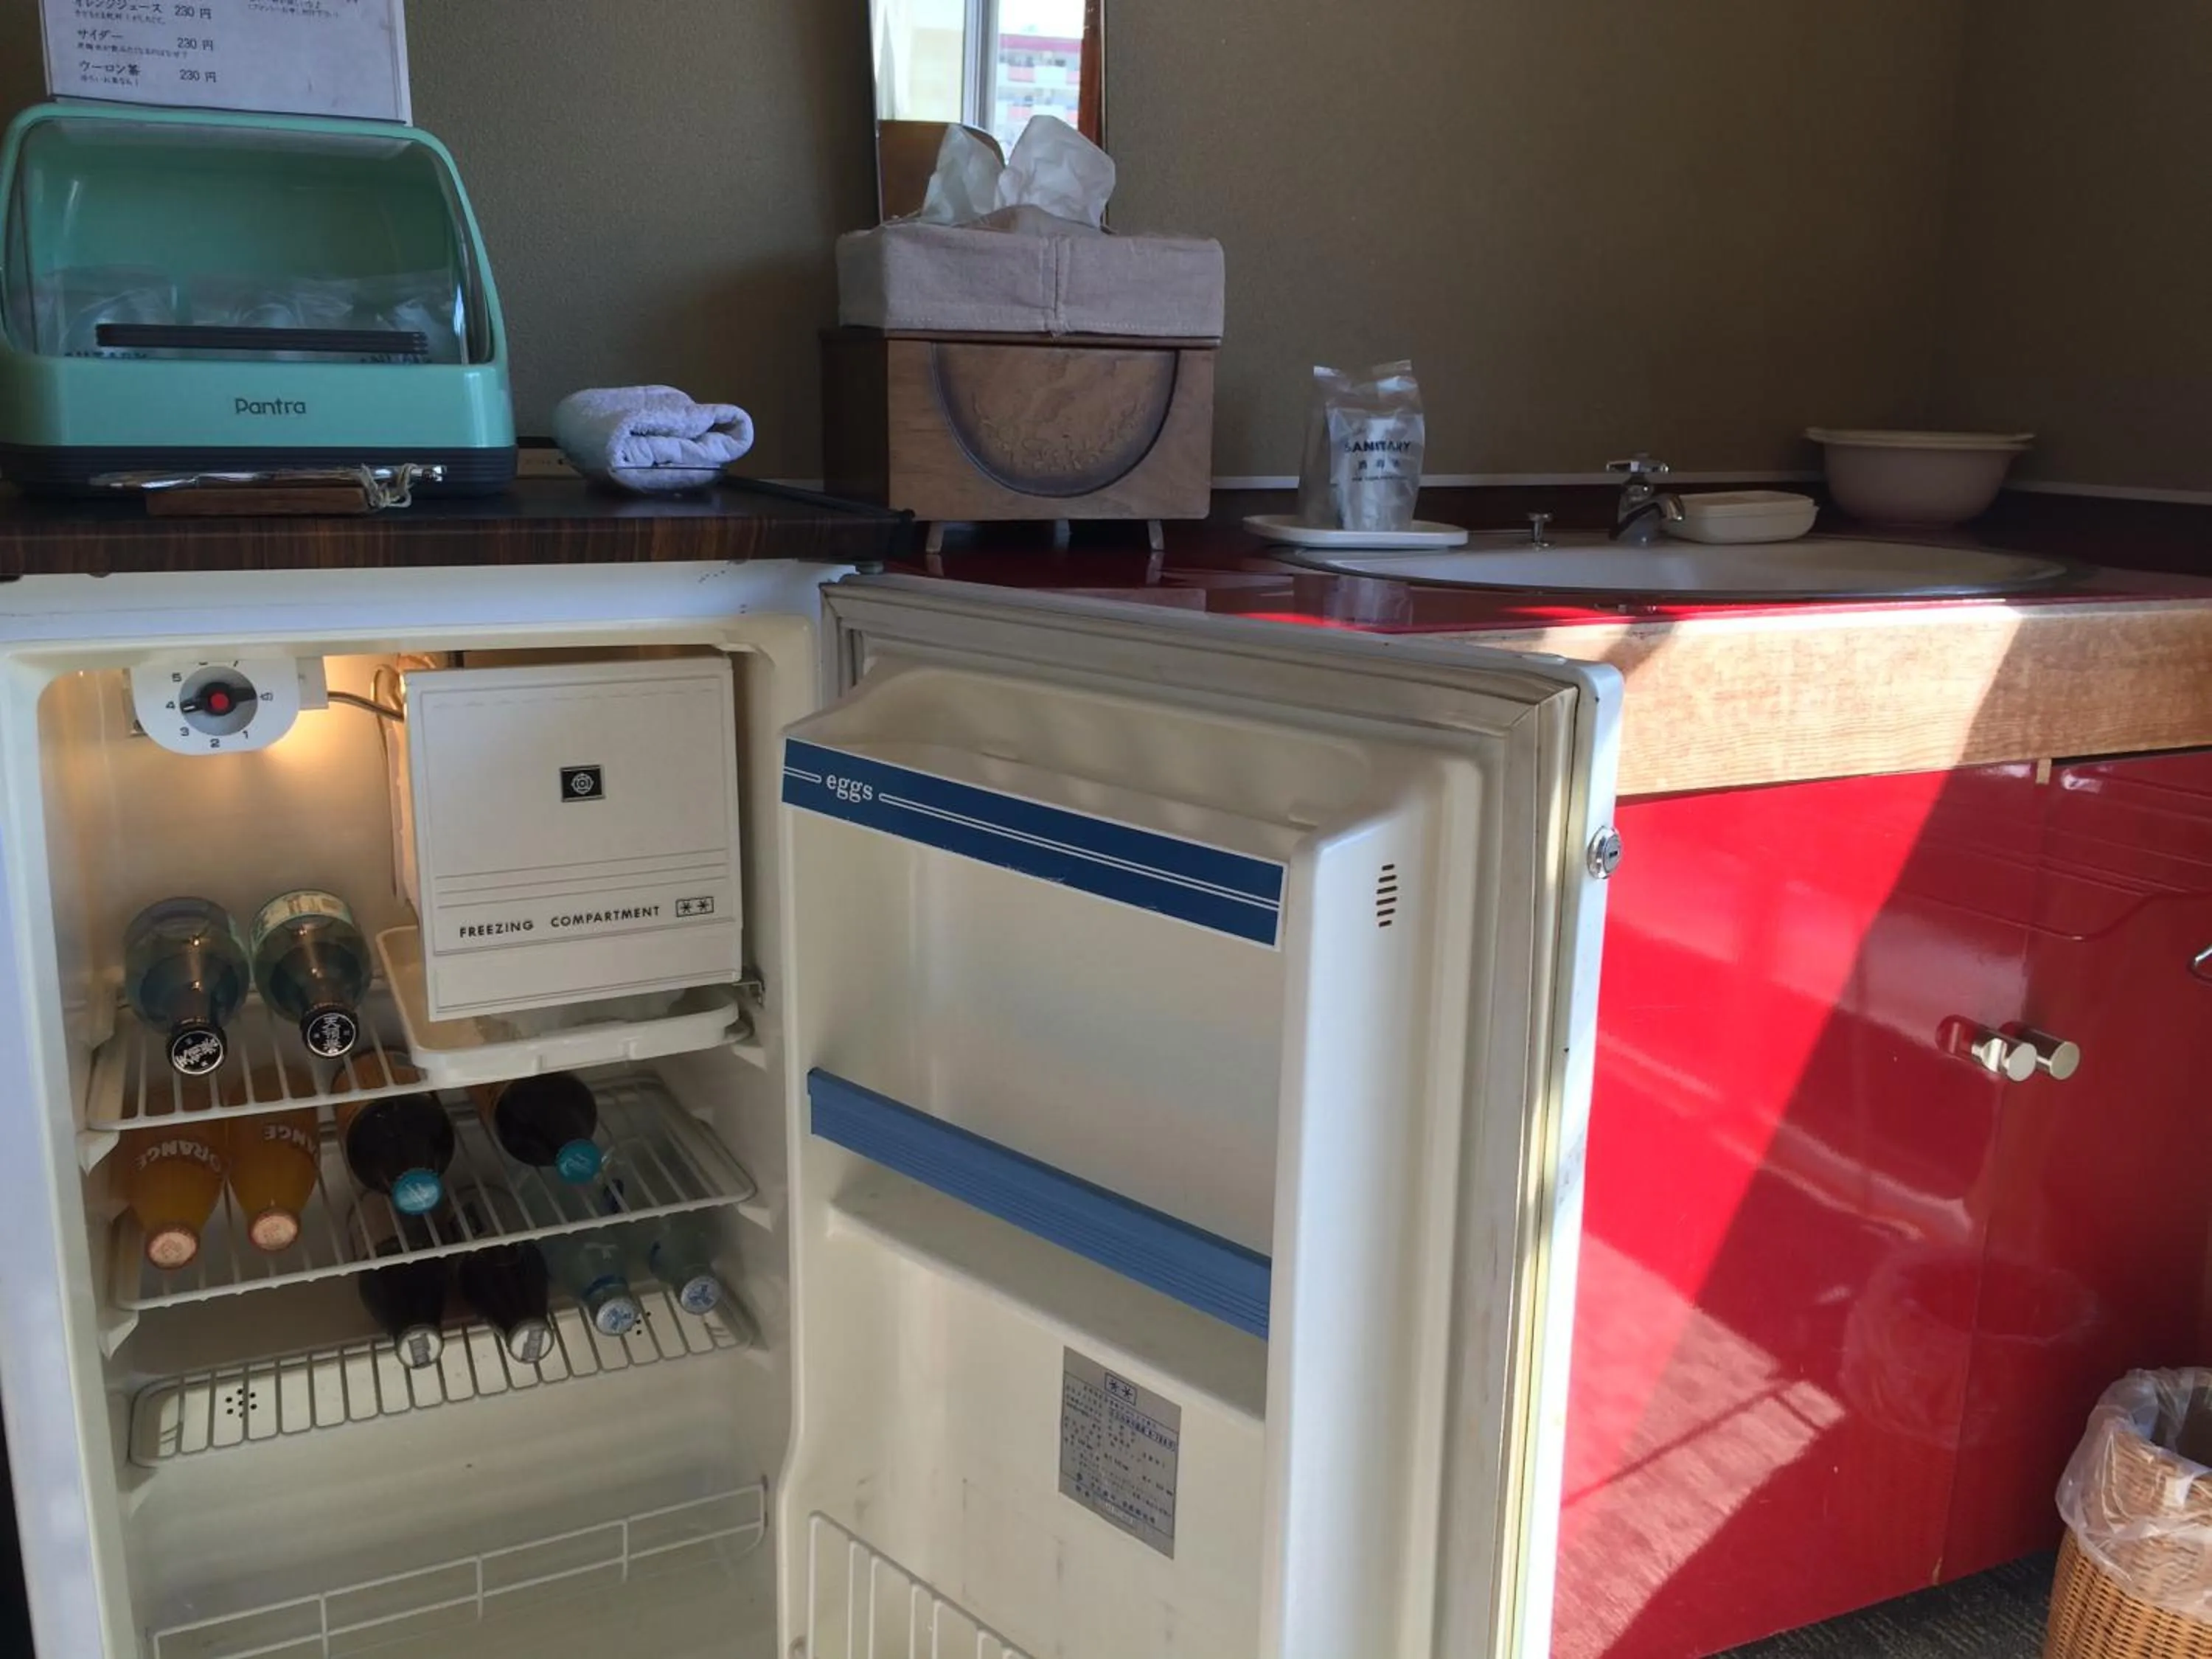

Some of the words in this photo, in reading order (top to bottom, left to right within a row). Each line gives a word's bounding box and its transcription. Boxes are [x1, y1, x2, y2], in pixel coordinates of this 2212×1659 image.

[174, 4, 195, 18] 230
[200, 7, 212, 20] 円
[77, 29, 124, 41] サイダー
[177, 37, 198, 50] 230
[202, 39, 214, 52] 円
[79, 60, 141, 77] ウーロン茶
[179, 69, 200, 82] 230
[205, 71, 217, 83] 円
[234, 397, 307, 415] Pantra
[172, 672, 181, 682] 5
[166, 701, 175, 709] 4
[180, 727, 189, 737] 3
[243, 731, 248, 739] 1
[210, 739, 220, 748] 2
[826, 774, 874, 803] eggs
[459, 919, 534, 939] FREEZING
[550, 905, 660, 928] COMPARTMENT
[134, 1139, 223, 1173] ORANGE
